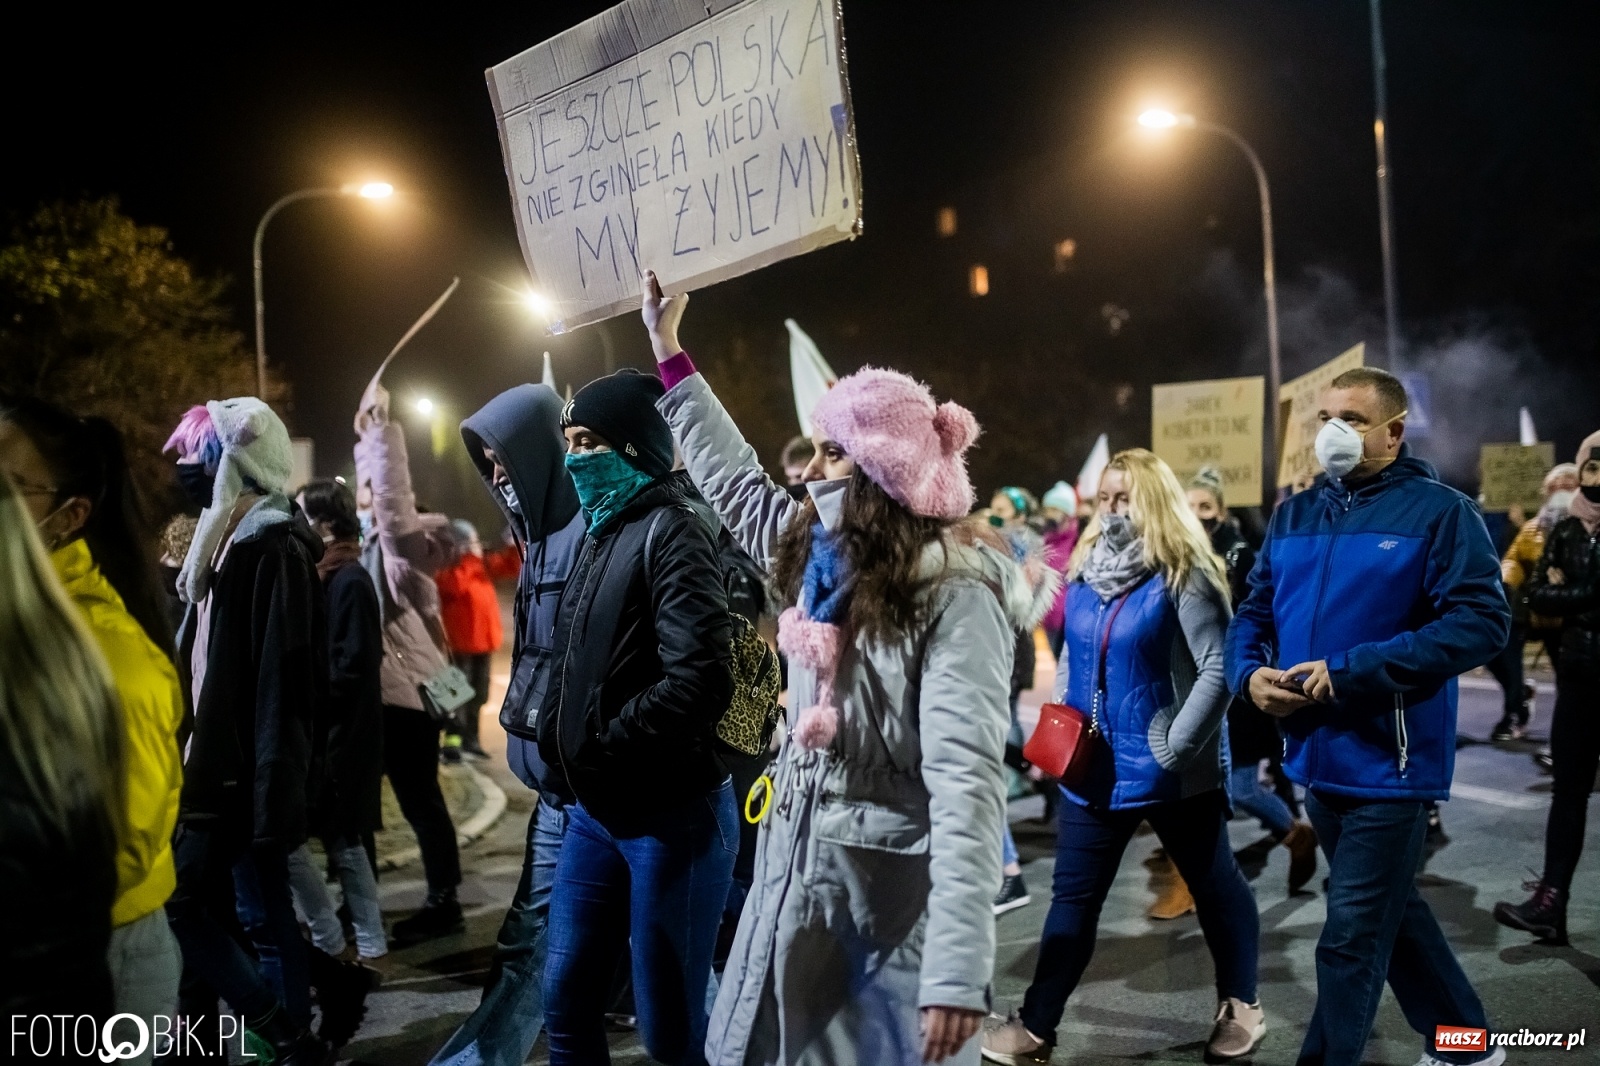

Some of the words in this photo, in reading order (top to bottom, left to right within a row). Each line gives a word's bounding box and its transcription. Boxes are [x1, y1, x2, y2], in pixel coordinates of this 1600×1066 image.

[520, 70, 661, 185] JESZCZE
[668, 0, 829, 117] POLSKA
[527, 186, 564, 225] NIE
[705, 88, 781, 158] KIEDY
[575, 207, 644, 289] MY
[1377, 539, 1399, 550] 4F
